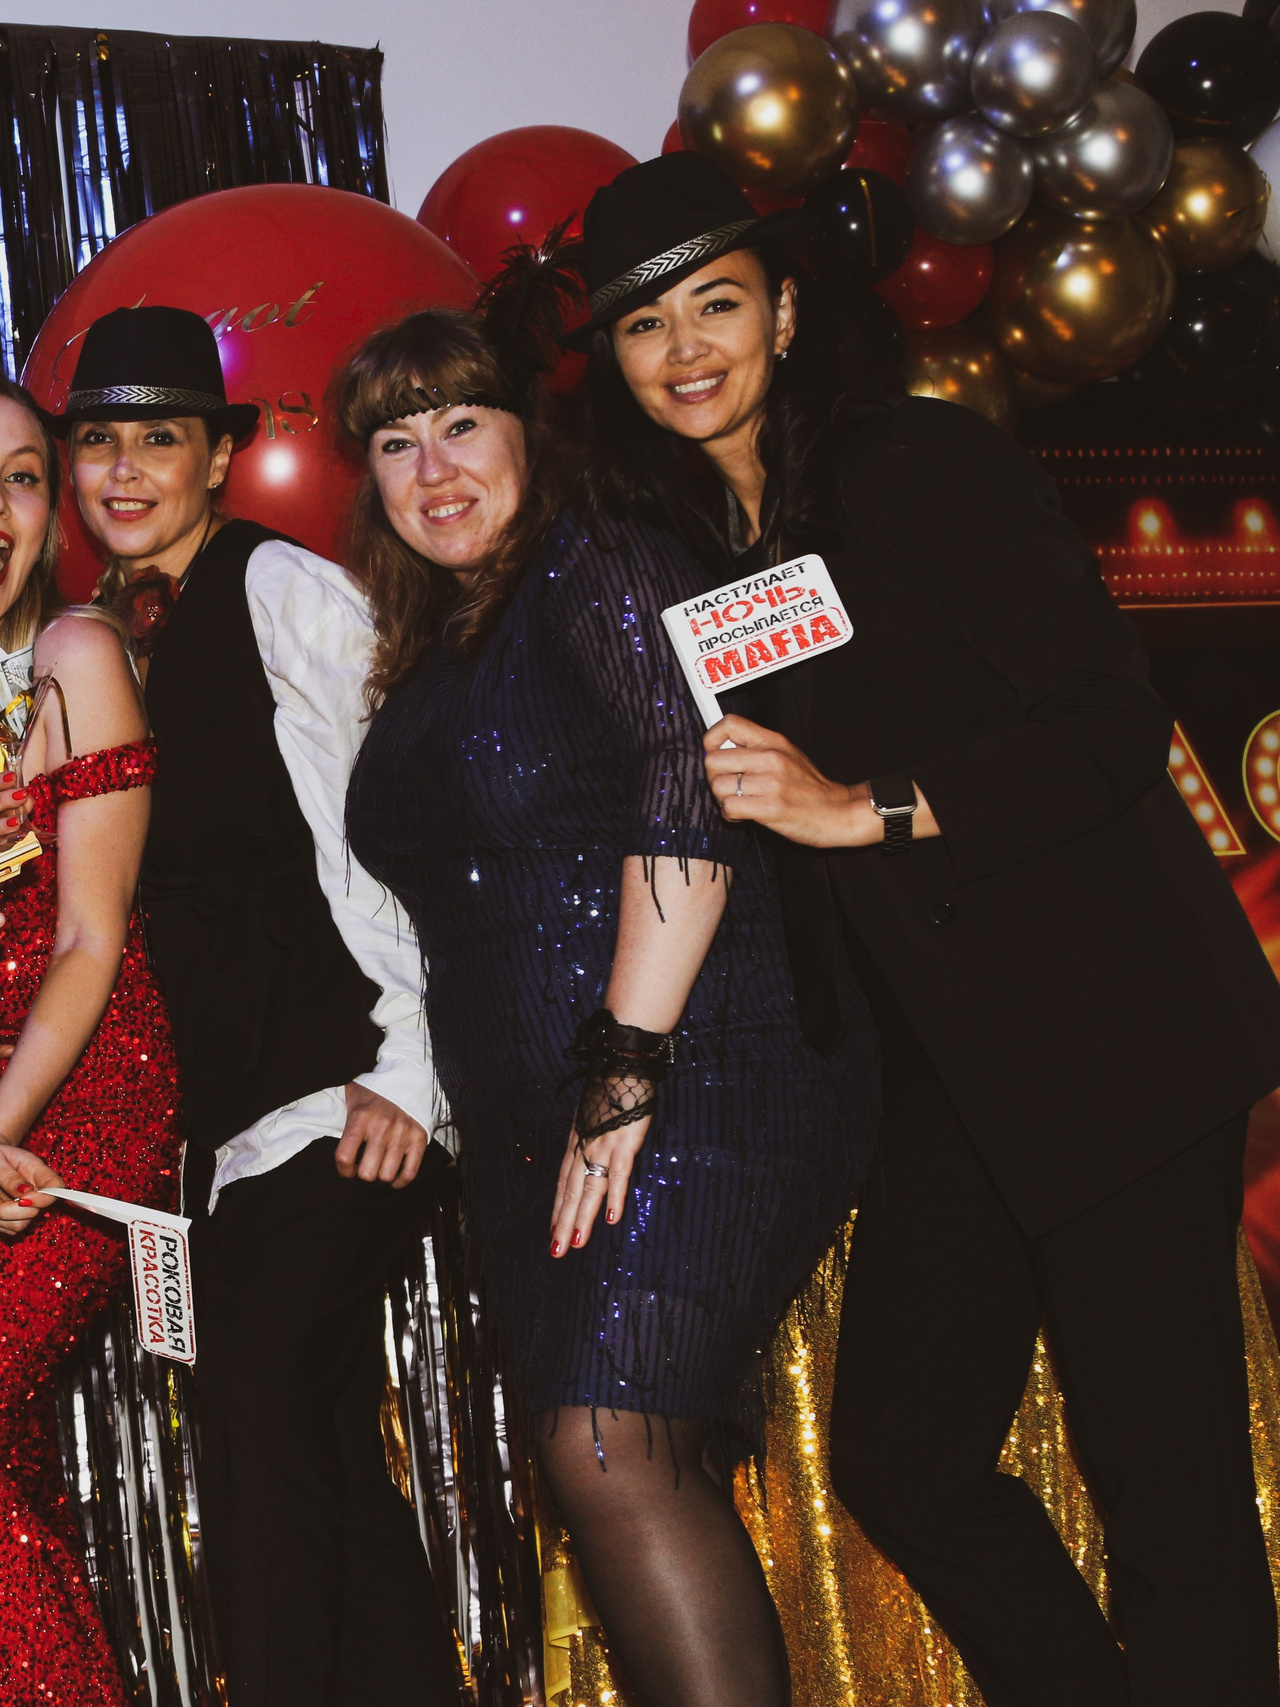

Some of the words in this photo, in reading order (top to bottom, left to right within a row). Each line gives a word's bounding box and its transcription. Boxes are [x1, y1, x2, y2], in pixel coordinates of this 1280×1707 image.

[684, 562, 806, 617] НАСТУПАЕТ
[698, 596, 825, 653] ПРОСЫПАЕТСЯ
[704, 614, 842, 684] MAFIA
[139, 1229, 166, 1344] КРАСОТКА
[159, 1234, 187, 1354] РОКОВАЯ
